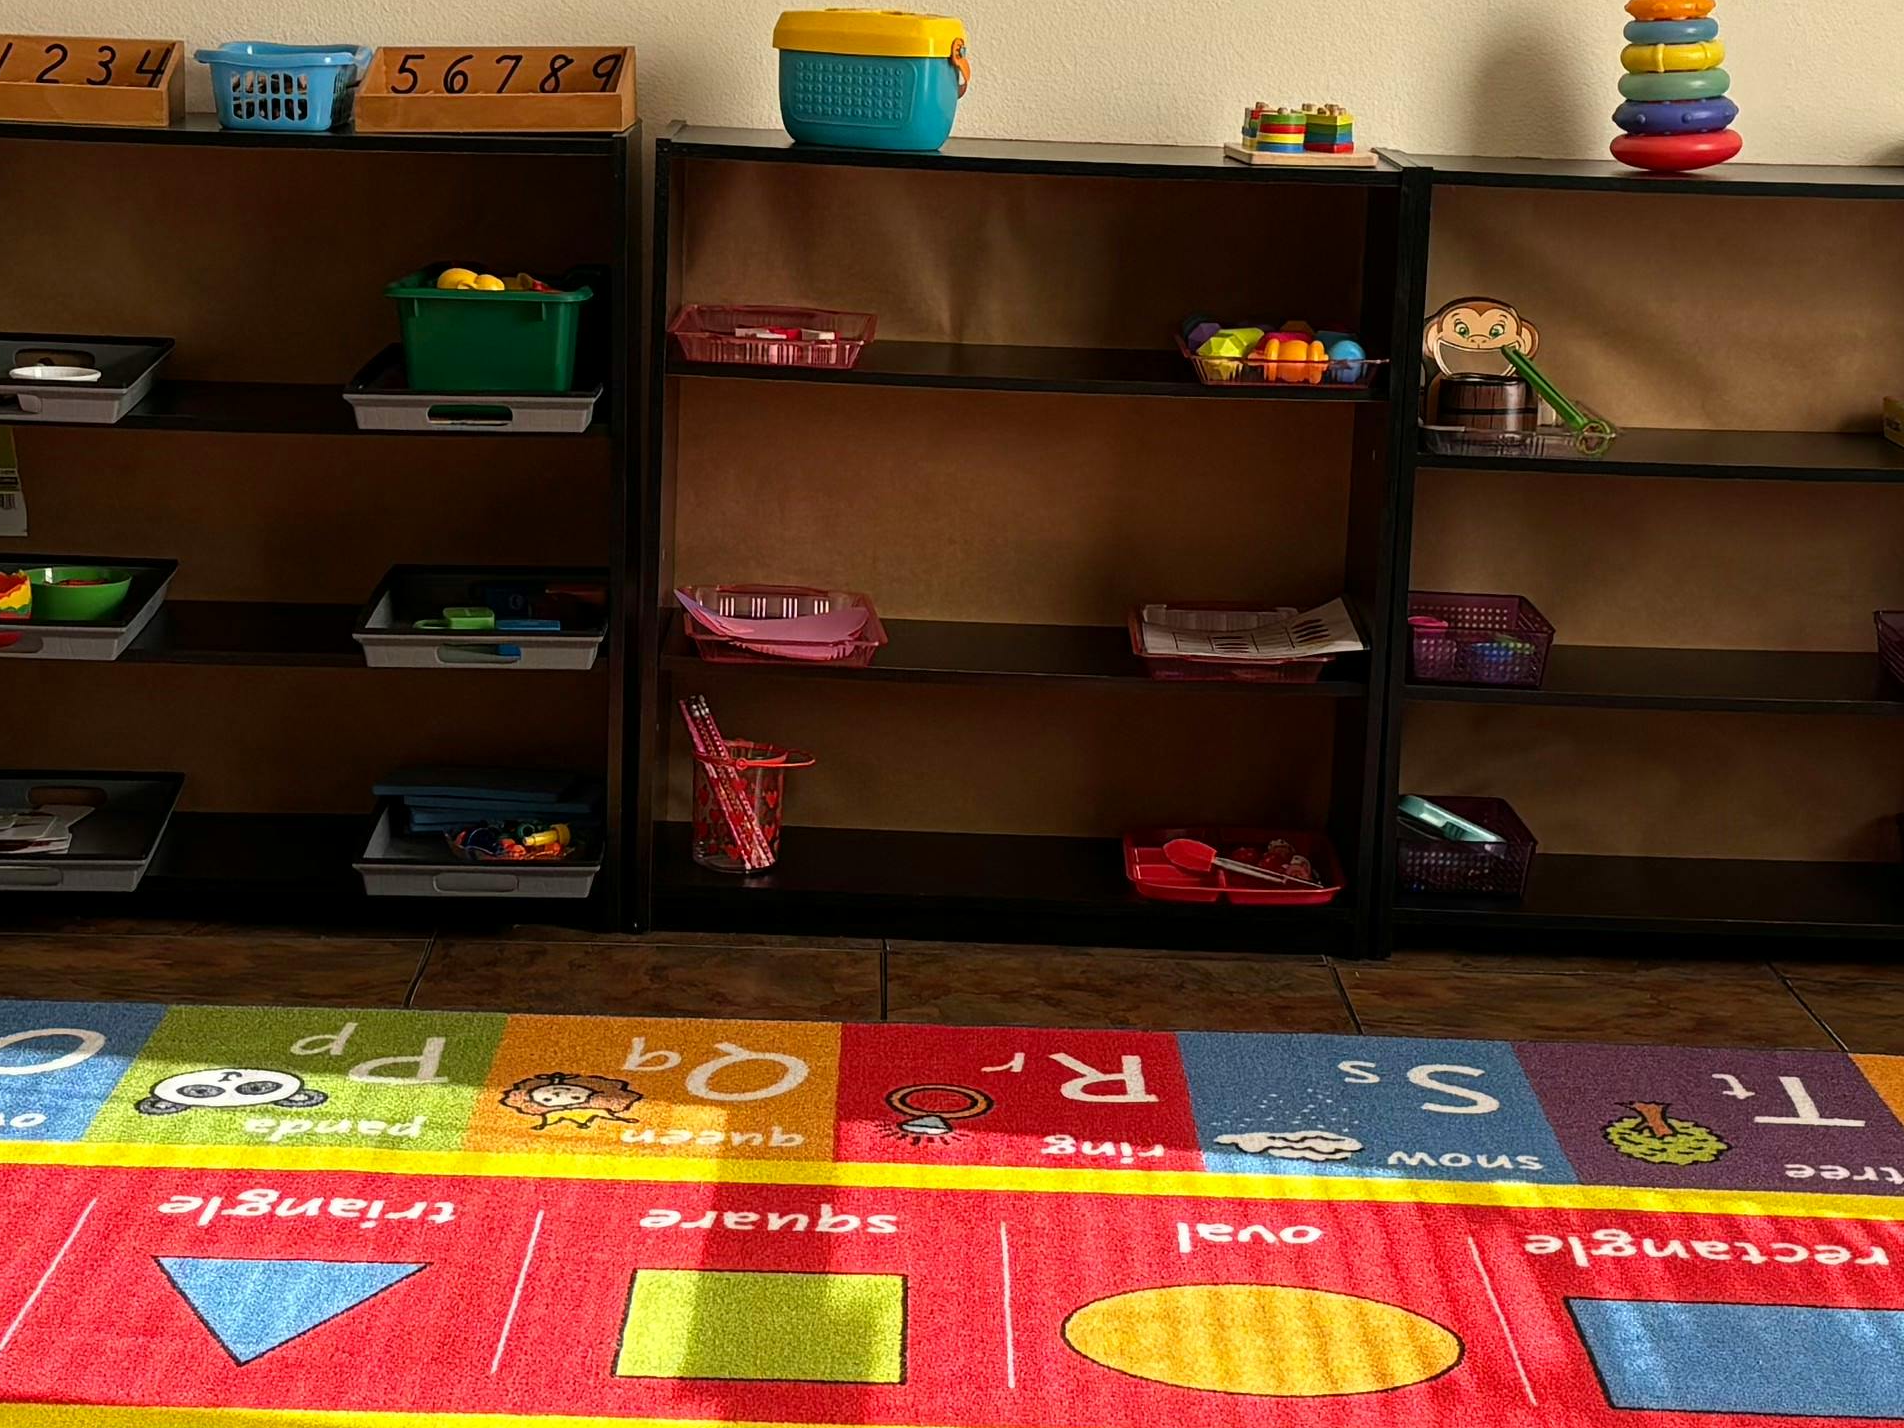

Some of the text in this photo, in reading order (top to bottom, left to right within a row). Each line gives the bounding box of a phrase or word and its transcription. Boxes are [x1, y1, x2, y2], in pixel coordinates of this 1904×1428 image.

[36, 43, 68, 84] 2
[86, 45, 117, 86] 3
[135, 47, 172, 89] 4
[390, 53, 623, 95] 5 6 7 8 9
[242, 1116, 426, 1142] panda
[618, 1127, 803, 1150] queen
[1040, 1135, 1165, 1165] ring
[1387, 1151, 1543, 1172] snow
[1786, 1164, 1904, 1184] tree
[158, 1188, 460, 1228] triangle
[639, 1204, 898, 1235] square
[1177, 1222, 1323, 1254] oval
[1525, 1229, 1889, 1267] rectangle
